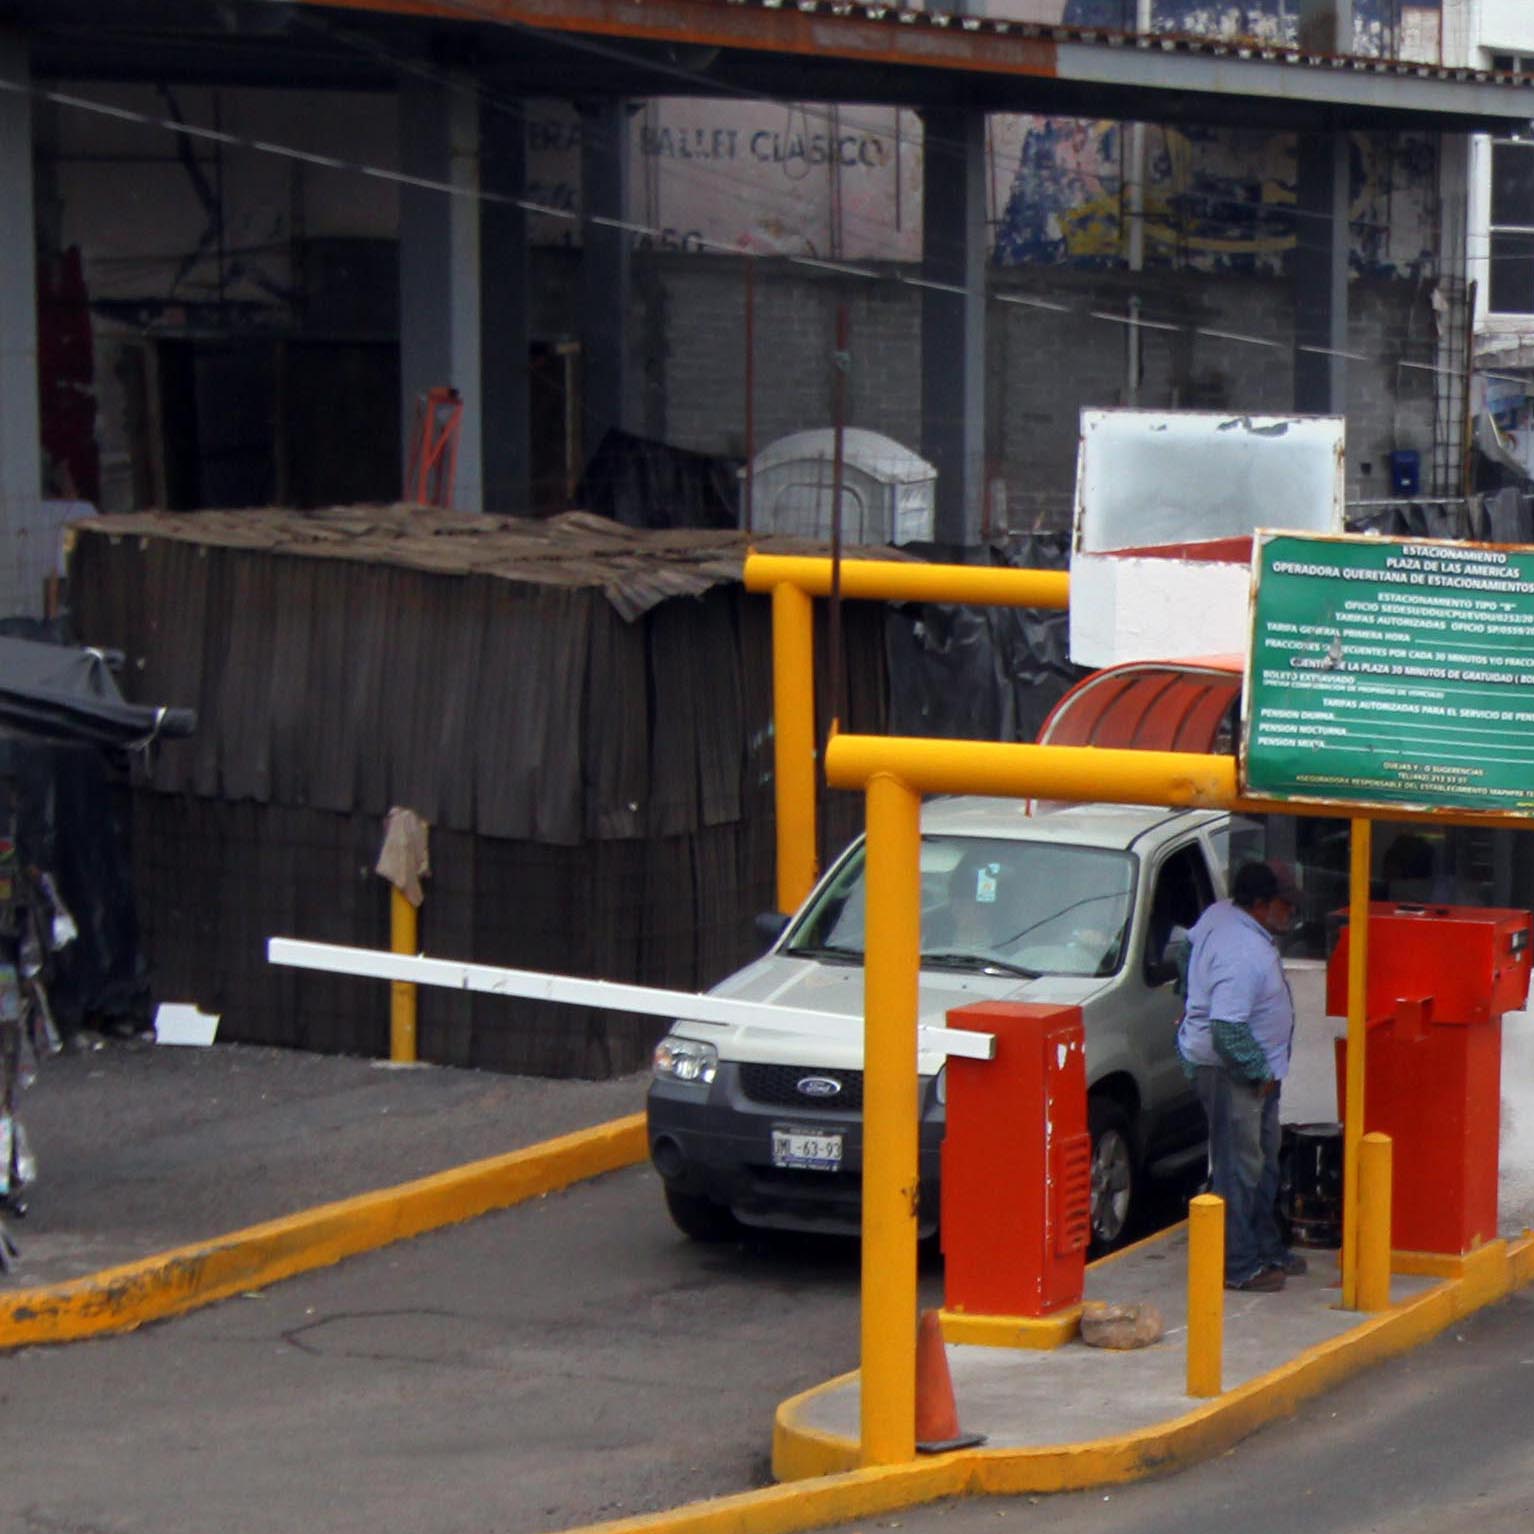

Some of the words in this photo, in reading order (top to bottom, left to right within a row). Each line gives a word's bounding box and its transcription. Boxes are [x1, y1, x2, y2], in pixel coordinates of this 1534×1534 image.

[1402, 545, 1507, 563] ESTACIONAMIENTO
[1387, 558, 1421, 571] PLAZA
[1424, 560, 1439, 571] DE
[1441, 562, 1462, 574] LAS
[1463, 565, 1520, 578] AMERICAS
[1272, 562, 1340, 577] OPERADORA
[1343, 569, 1408, 584] QUERETANA
[1410, 573, 1425, 584] DE
[1428, 574, 1534, 593] ESTACIONAMIENTOS
[1345, 601, 1379, 612] OFICIO
[1378, 592, 1472, 609] ESTACIONAMIENTO
[1475, 599, 1497, 610] TIPO
[1335, 612, 1375, 624] TARIFAS
[1376, 615, 1447, 630] AUTORIZADAS
[1451, 622, 1485, 633] OFICIO
[1266, 622, 1298, 634] TARIFA
[1343, 629, 1384, 640] PRIMERA
[1384, 632, 1411, 642] HORA
[1388, 649, 1407, 659] POR
[1408, 650, 1433, 661] CADA
[1447, 653, 1487, 665] MINUTOS
[1263, 670, 1297, 680] BOLETO
[1347, 661, 1360, 672] LA
[1361, 662, 1390, 674] PLAZA
[1404, 666, 1445, 678] MINUTOS
[1447, 669, 1461, 680] DE
[1462, 671, 1513, 684] GRATUIDAD
[1261, 708, 1299, 719] PENSION
[1323, 698, 1358, 709] TARIFAS
[1358, 701, 1420, 714] AUTORIZADAS
[1421, 705, 1445, 715] PARA
[1447, 708, 1457, 717] EL
[1459, 709, 1500, 720] SERVICIO
[1501, 712, 1514, 721] DE
[1259, 722, 1298, 733] PENSION
[1299, 725, 1347, 735] NOCTURNA
[1257, 736, 1296, 747] PENSION
